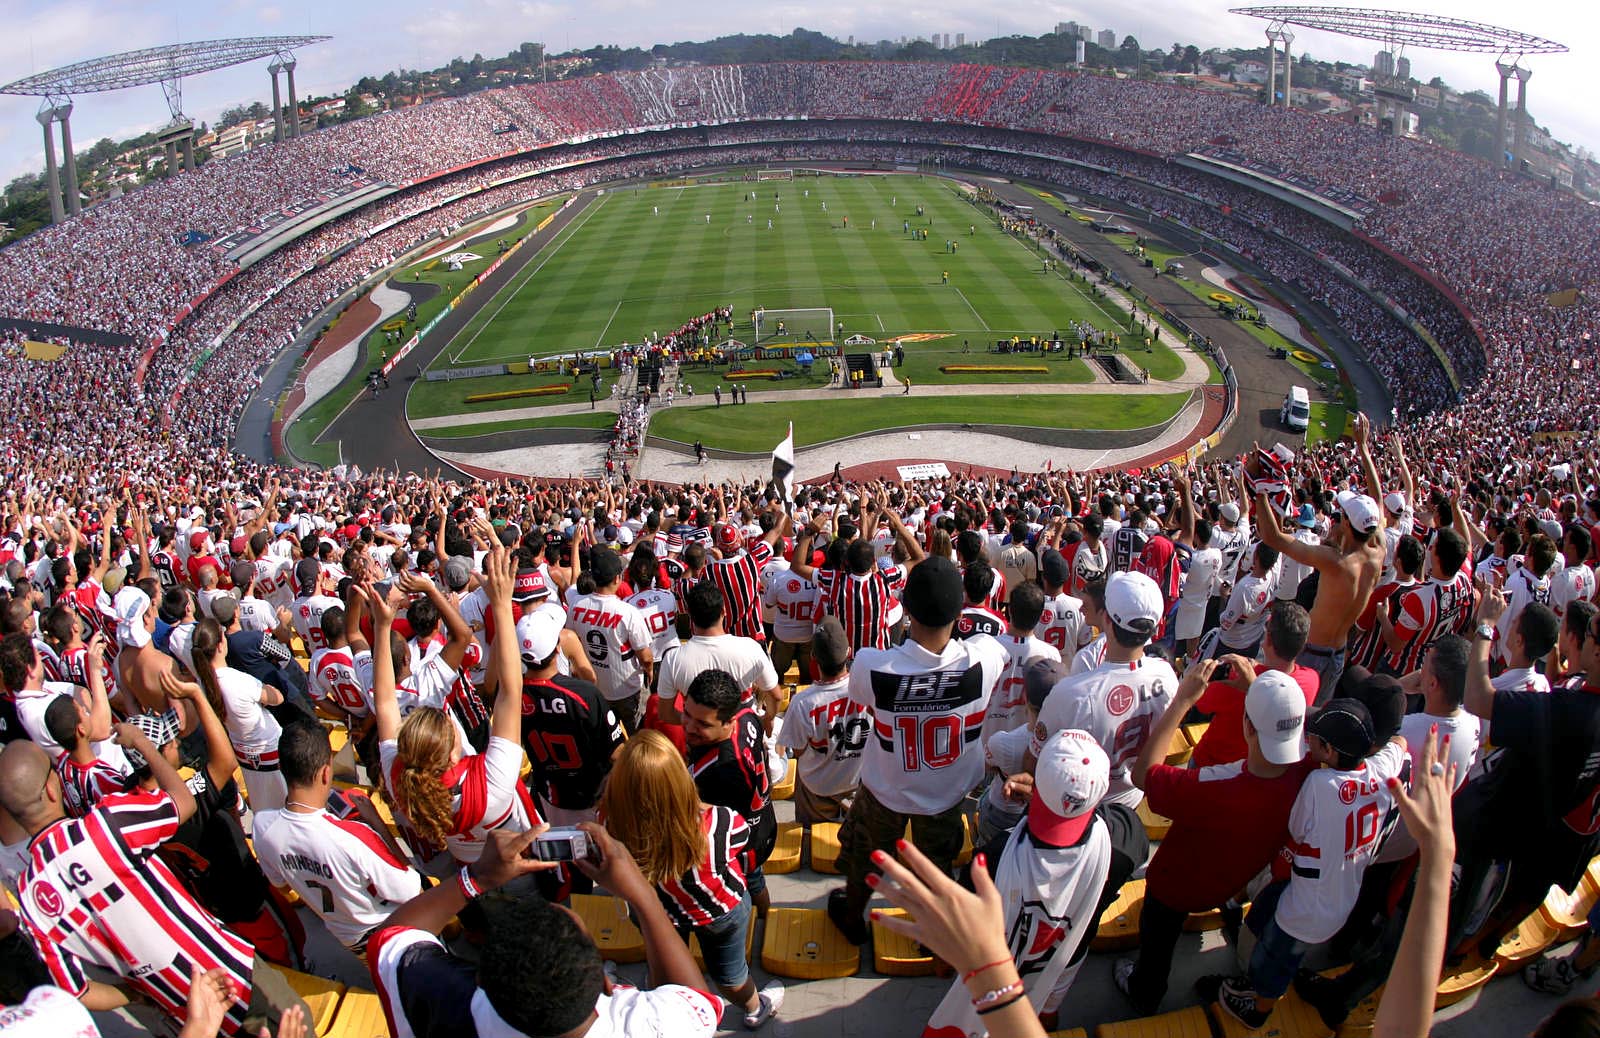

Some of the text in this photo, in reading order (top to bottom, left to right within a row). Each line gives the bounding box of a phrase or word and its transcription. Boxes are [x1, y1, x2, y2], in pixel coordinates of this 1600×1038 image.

[572, 606, 624, 629] TAM
[975, 622, 992, 633] LG
[1057, 610, 1073, 620] LG
[894, 671, 965, 701] IBF
[1140, 678, 1164, 702] LG
[540, 697, 567, 714] LG
[527, 729, 583, 769] 10
[894, 712, 964, 772] 10
[1359, 778, 1380, 796] LG
[1344, 801, 1379, 853] 10
[58, 862, 94, 893] LG
[304, 880, 335, 913] 7
